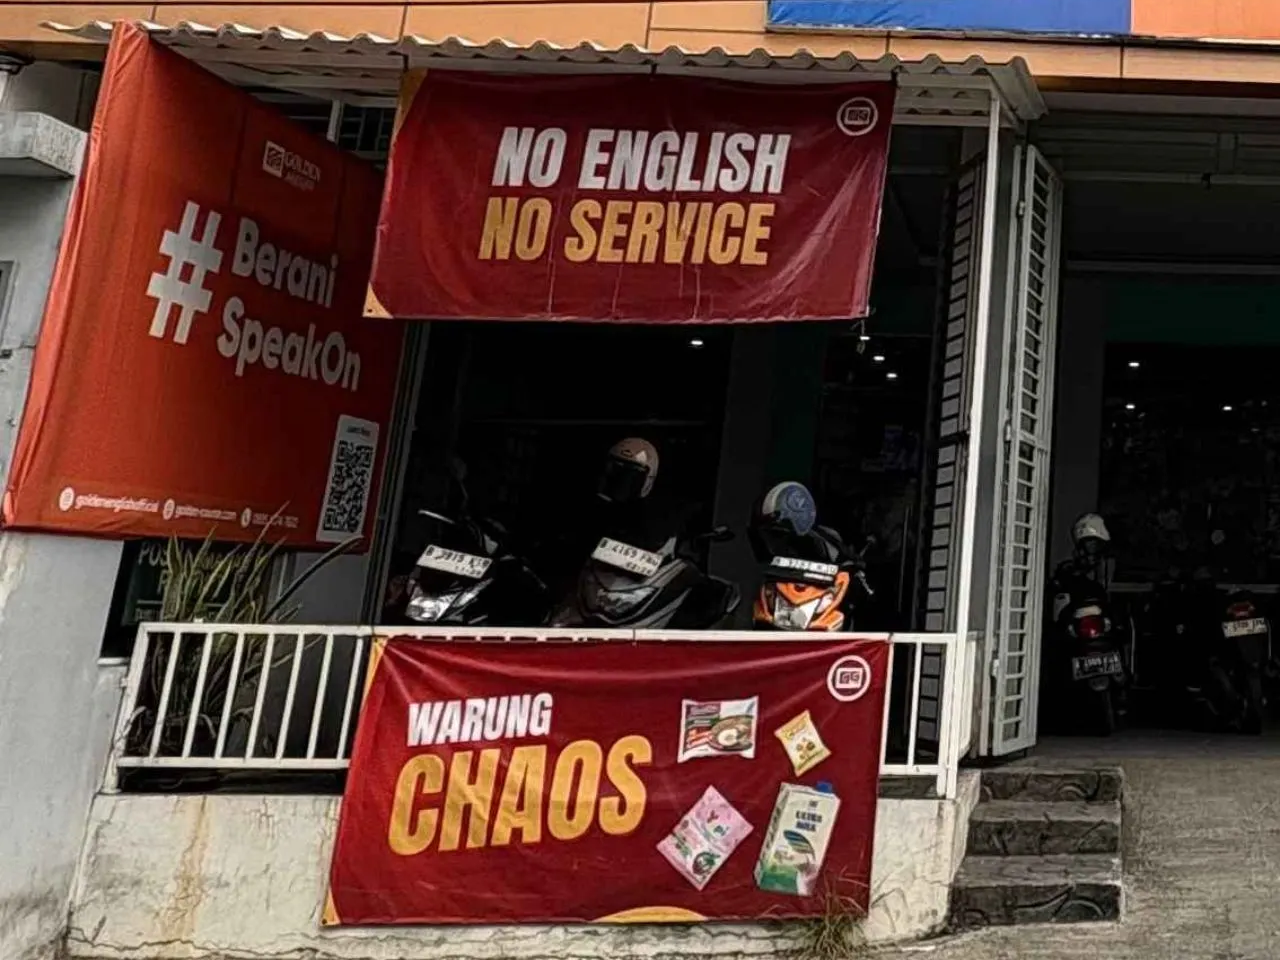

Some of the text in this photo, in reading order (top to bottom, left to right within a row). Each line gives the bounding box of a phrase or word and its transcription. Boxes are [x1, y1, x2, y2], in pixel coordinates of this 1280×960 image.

[492, 126, 792, 194] NO ENGLISH
[232, 217, 339, 308] Berani
[478, 196, 776, 266] NO SERVICE
[217, 296, 361, 392] SpeakOn
[407, 693, 553, 747] WARUNG
[388, 735, 653, 856] CHAOS
